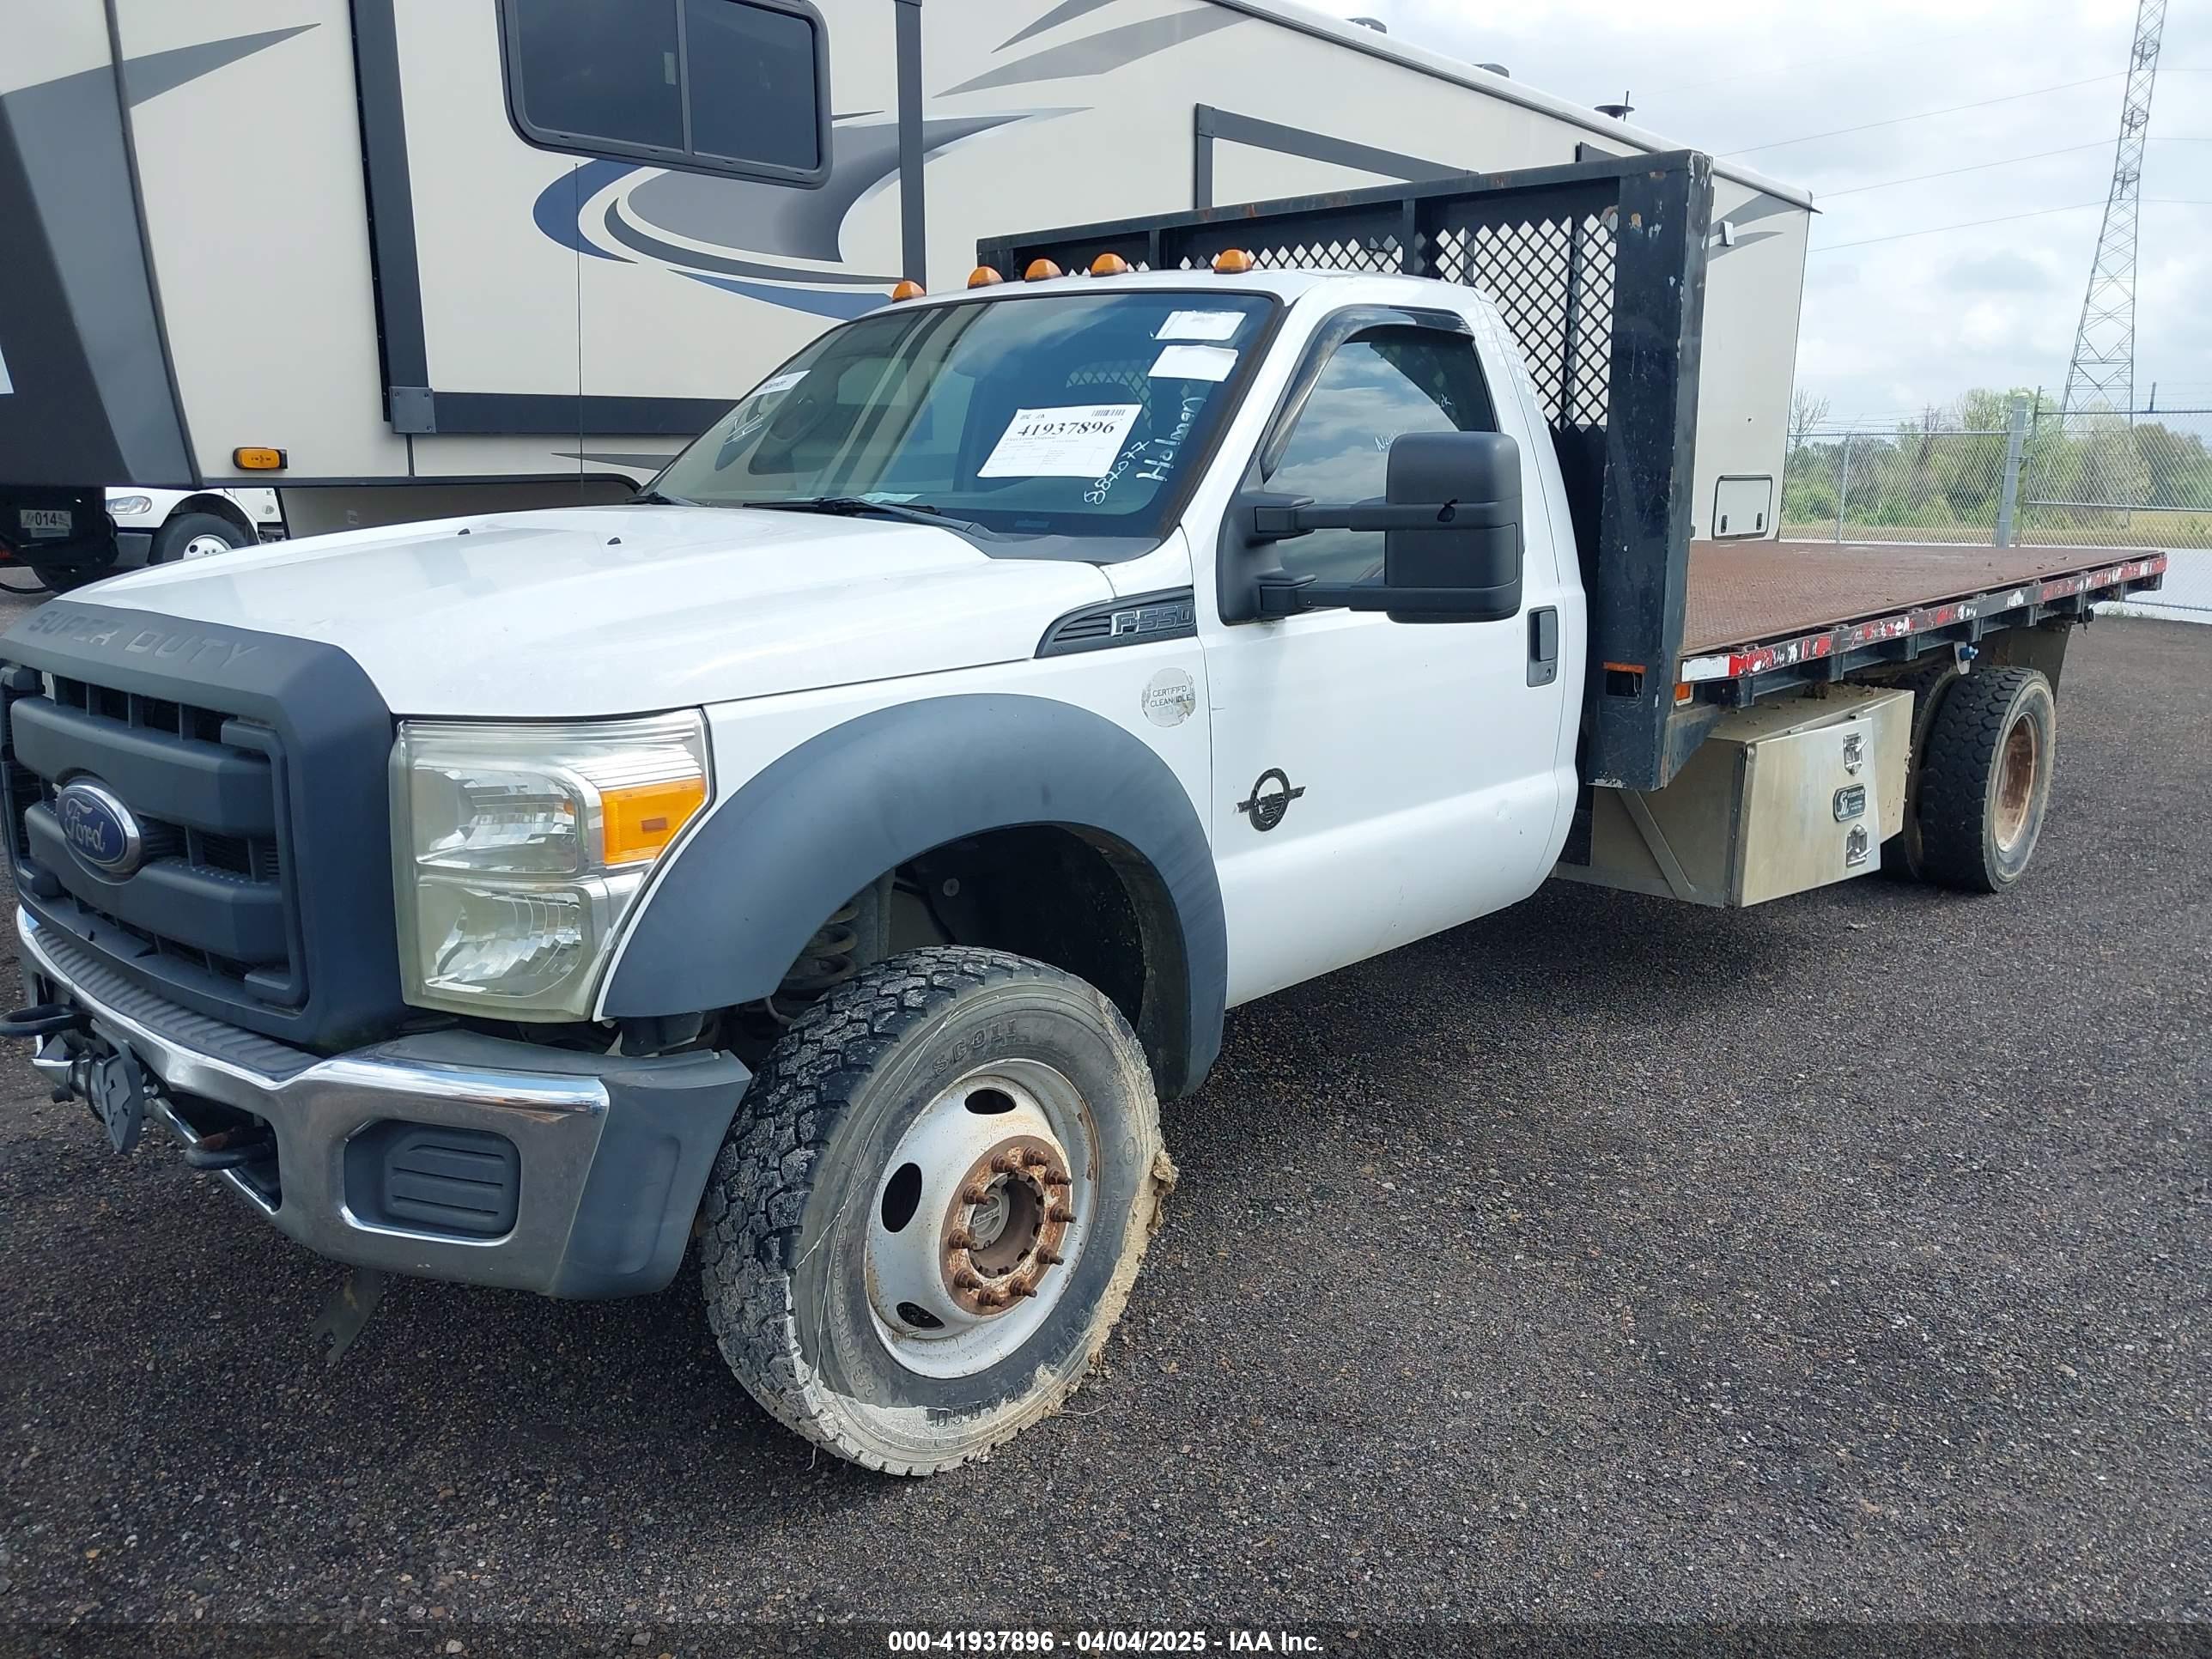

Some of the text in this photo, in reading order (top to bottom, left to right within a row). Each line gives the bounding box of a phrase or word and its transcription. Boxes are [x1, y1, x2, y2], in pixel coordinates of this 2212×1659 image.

[1018, 421, 1118, 436] 41937896
[27, 611, 260, 669] SUPER DUTY
[1150, 693, 1191, 708] CLEAN IDLE
[64, 798, 106, 854] Ford
